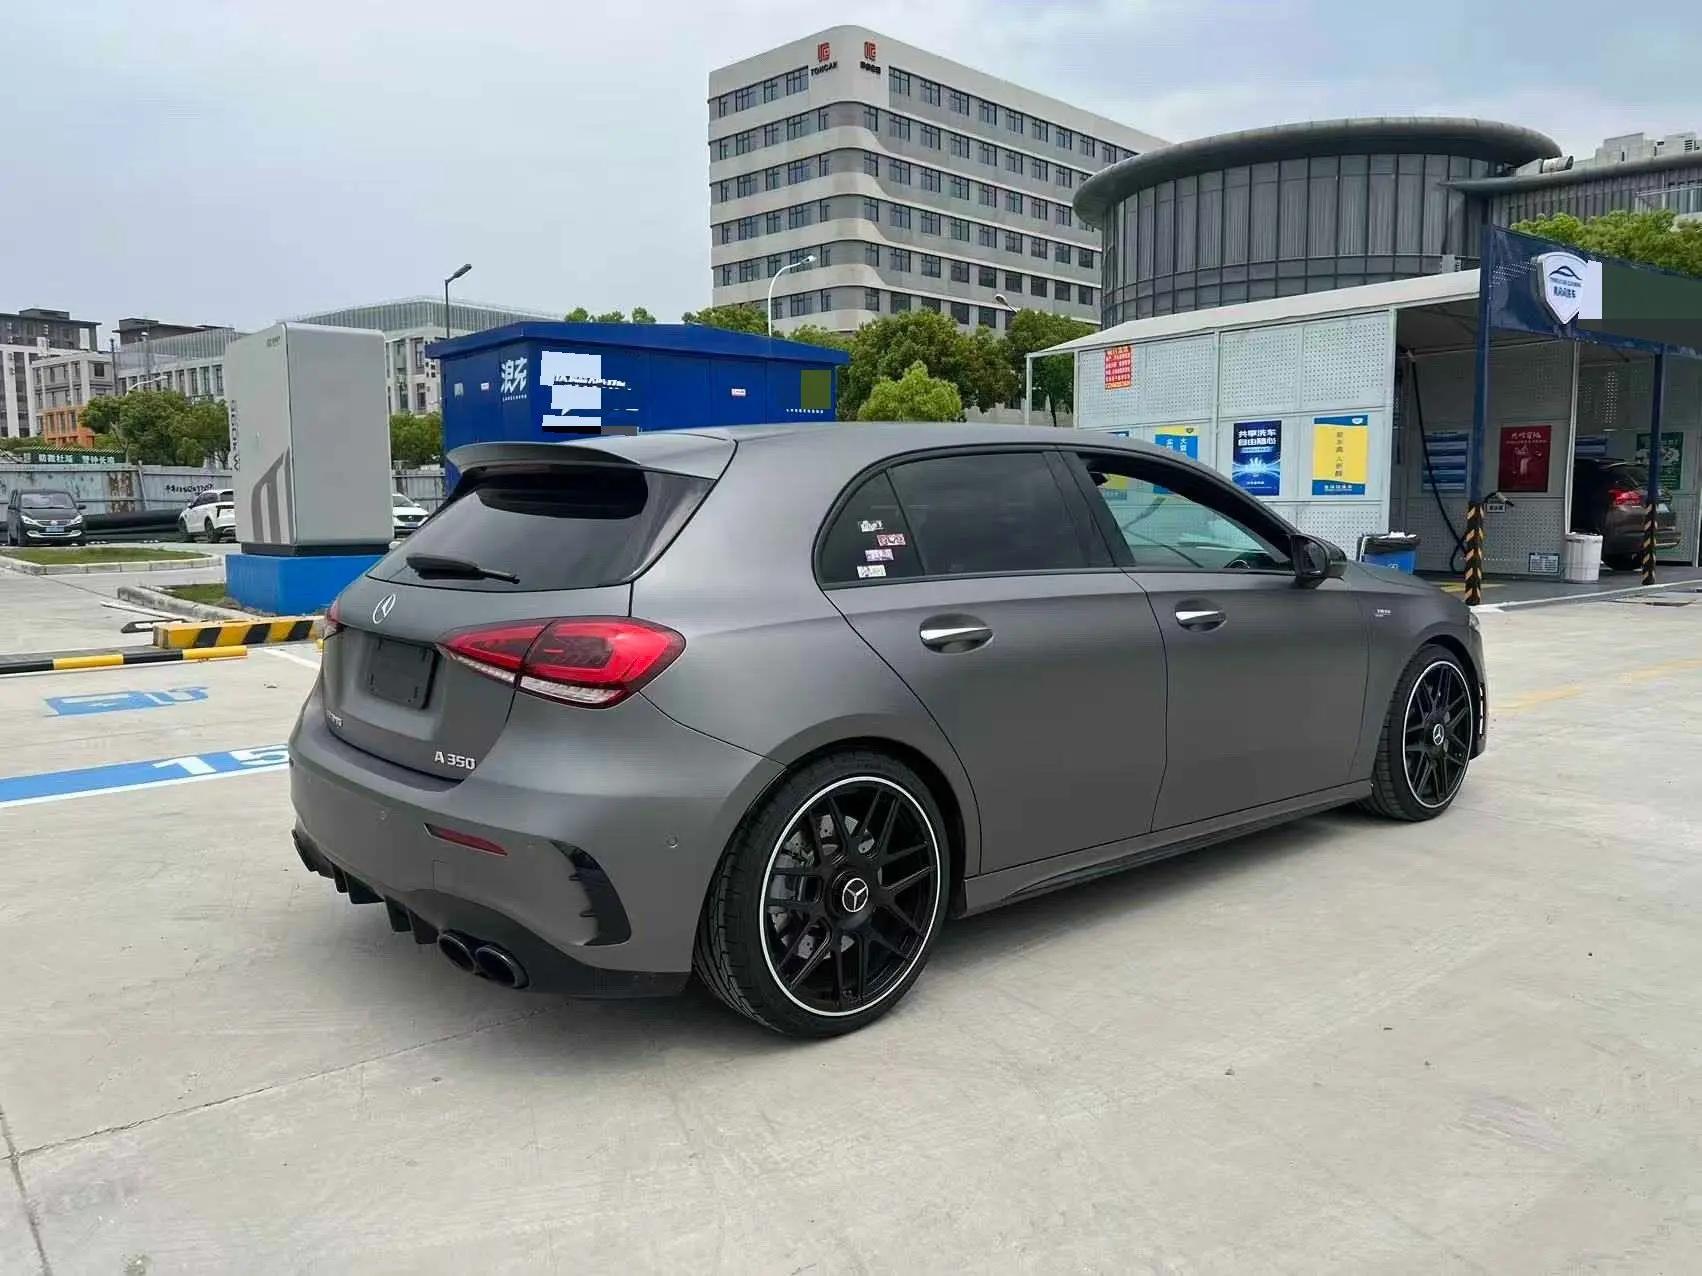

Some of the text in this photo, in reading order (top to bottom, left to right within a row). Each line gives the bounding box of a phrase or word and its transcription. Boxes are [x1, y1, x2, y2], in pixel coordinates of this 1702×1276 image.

[1238, 429, 1277, 438] 共享洗车
[1238, 438, 1277, 446] 自由随心
[434, 751, 476, 770] A 350
